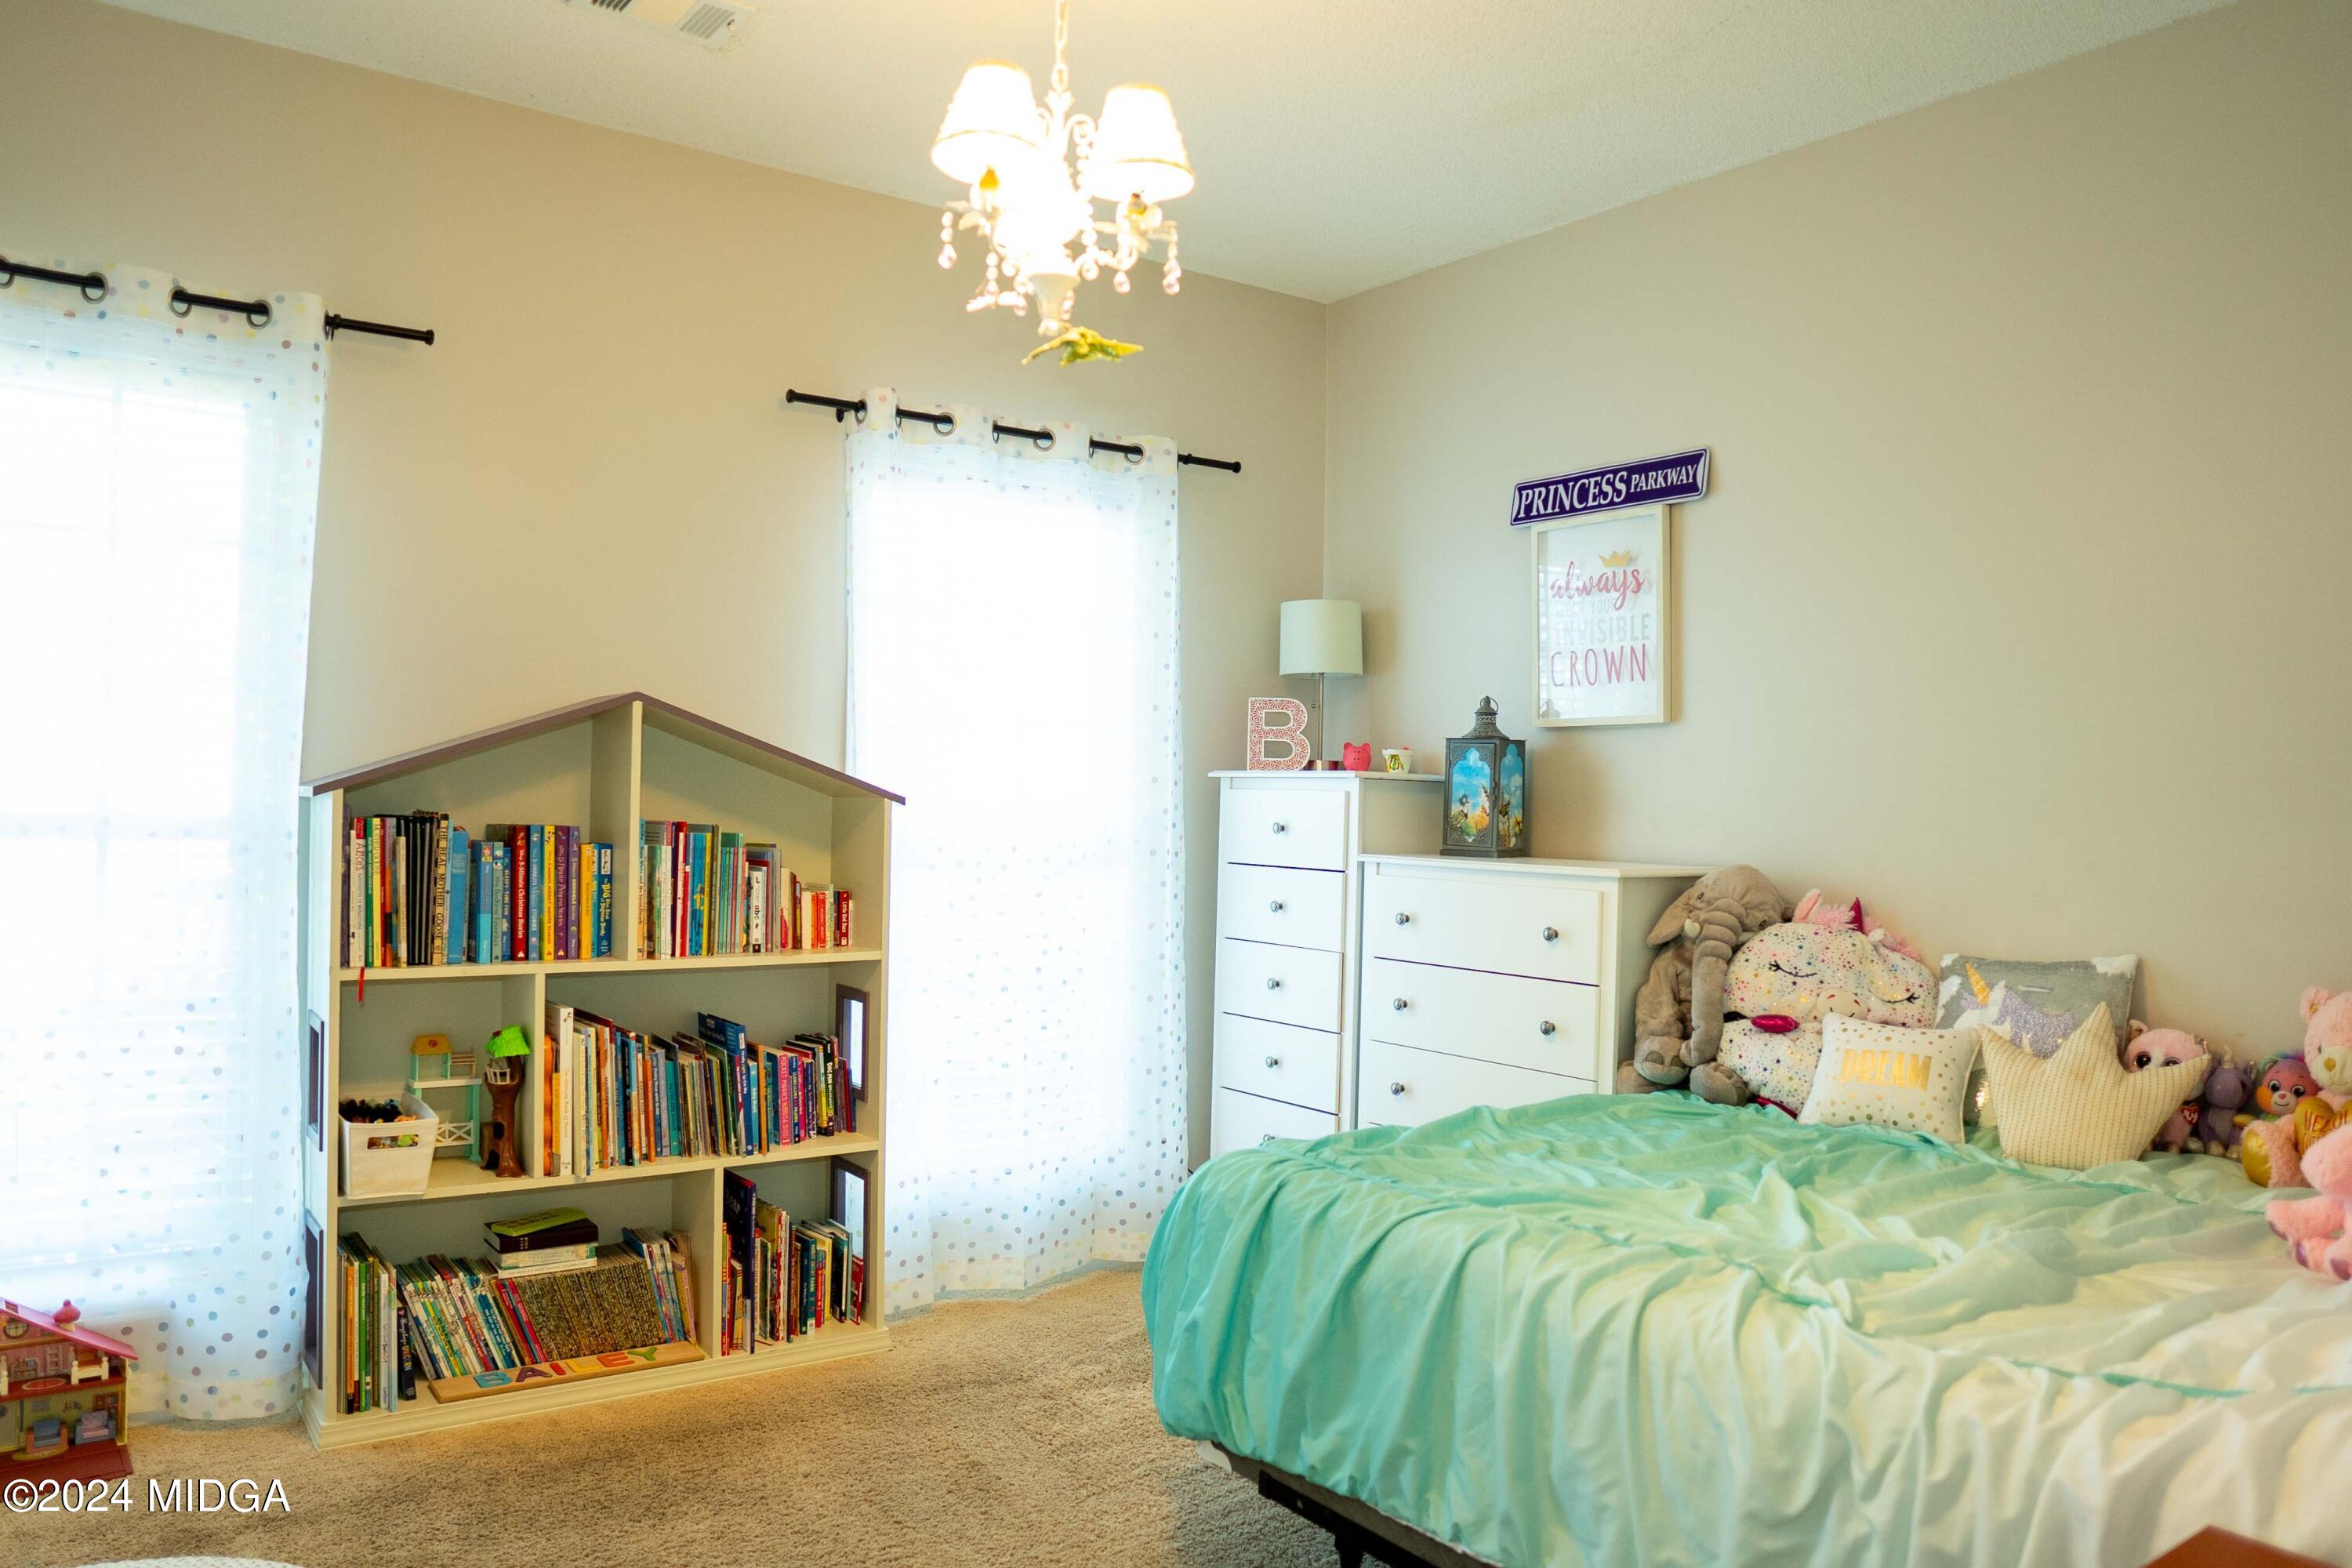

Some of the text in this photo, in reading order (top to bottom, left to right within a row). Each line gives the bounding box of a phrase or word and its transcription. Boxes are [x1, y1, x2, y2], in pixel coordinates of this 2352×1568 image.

[1517, 464, 1697, 518] PRINCESS PARKWAY
[1550, 561, 1646, 610] always
[1556, 613, 1650, 647] INVISIBLE
[1551, 644, 1646, 687] CROWN
[1247, 697, 1311, 771] B
[438, 847, 447, 868] REAL
[437, 873, 446, 907] MOTHER
[601, 883, 611, 898] BIG
[435, 913, 444, 941] GOOSE
[1839, 1048, 1933, 1091] DREAM
[474, 1346, 657, 1388] BAILEY
